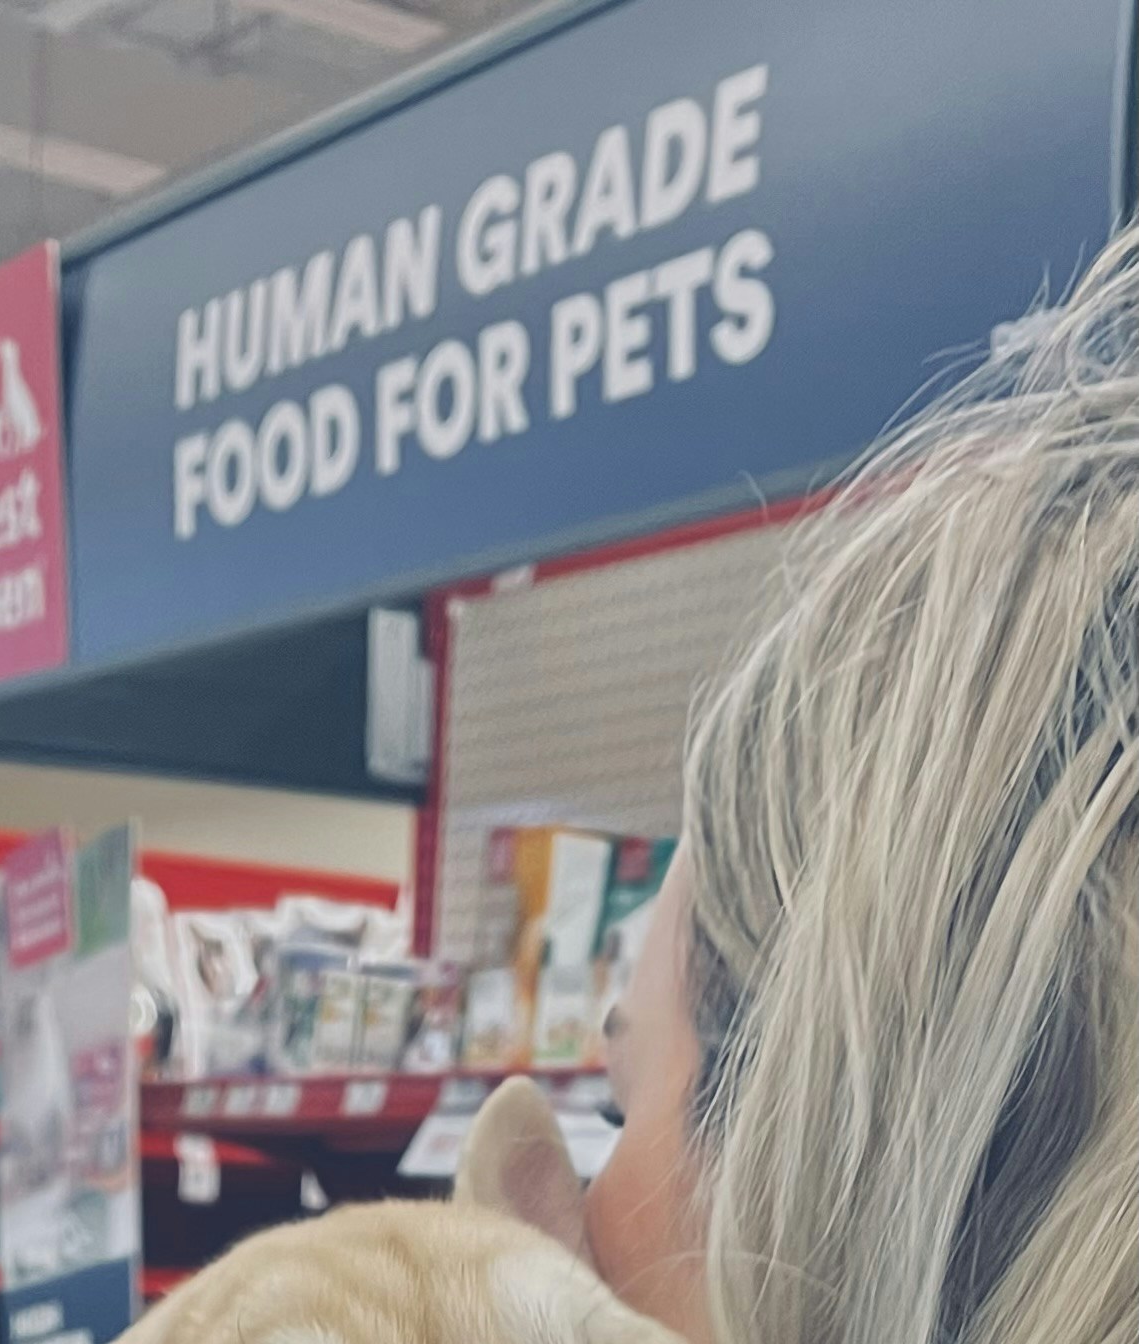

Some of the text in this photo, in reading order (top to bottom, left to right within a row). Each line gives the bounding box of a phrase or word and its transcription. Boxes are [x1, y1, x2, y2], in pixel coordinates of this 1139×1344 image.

[174, 63, 769, 411] HUMAN GRADE
[174, 229, 774, 541] FOOD FOR PETS
